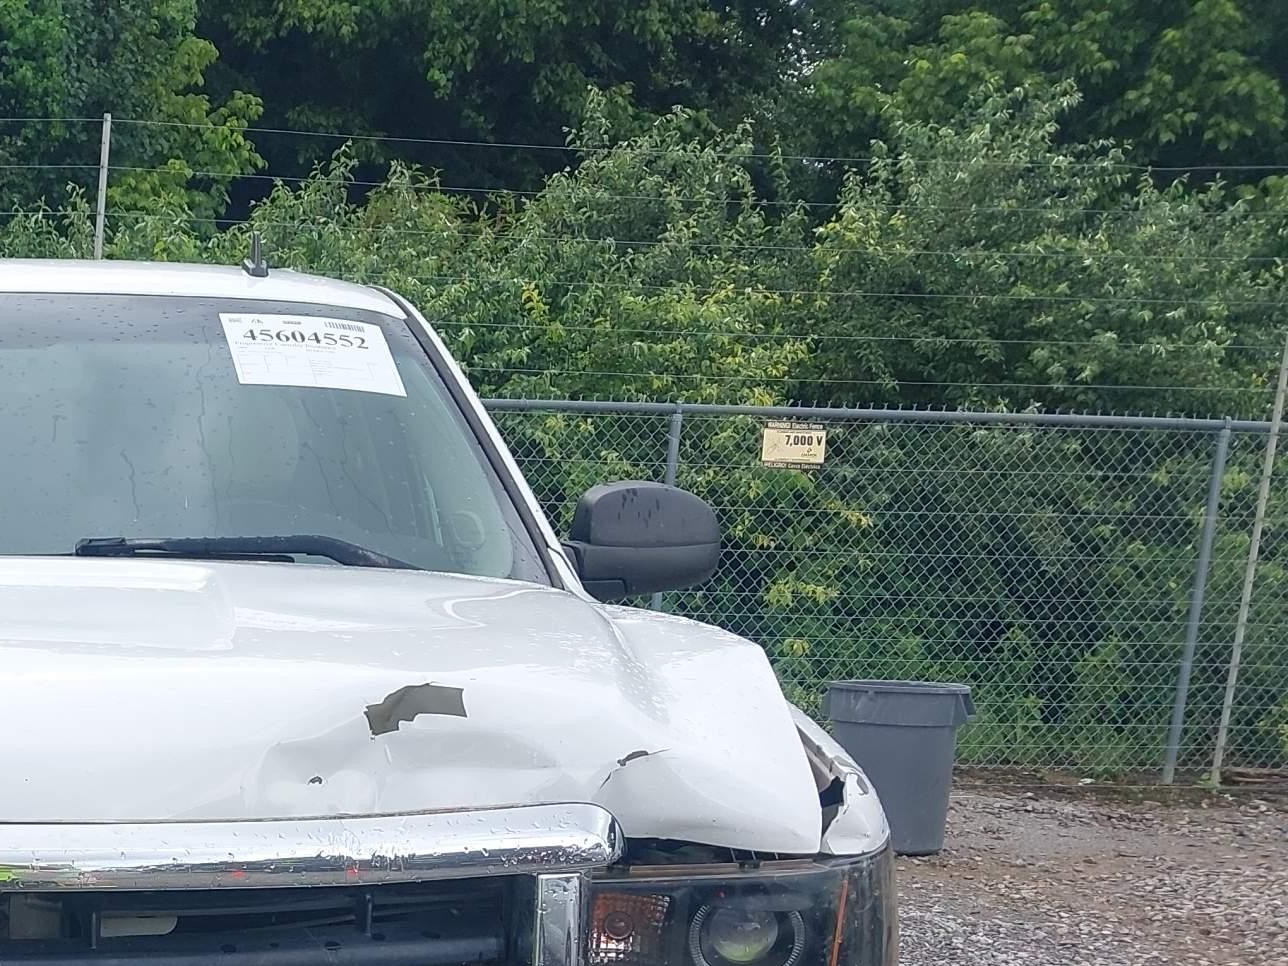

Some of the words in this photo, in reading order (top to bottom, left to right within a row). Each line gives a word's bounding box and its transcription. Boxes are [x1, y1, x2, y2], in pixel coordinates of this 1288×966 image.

[242, 328, 369, 350] 45604552
[785, 435, 813, 447] 7,000
[816, 435, 823, 446] V
